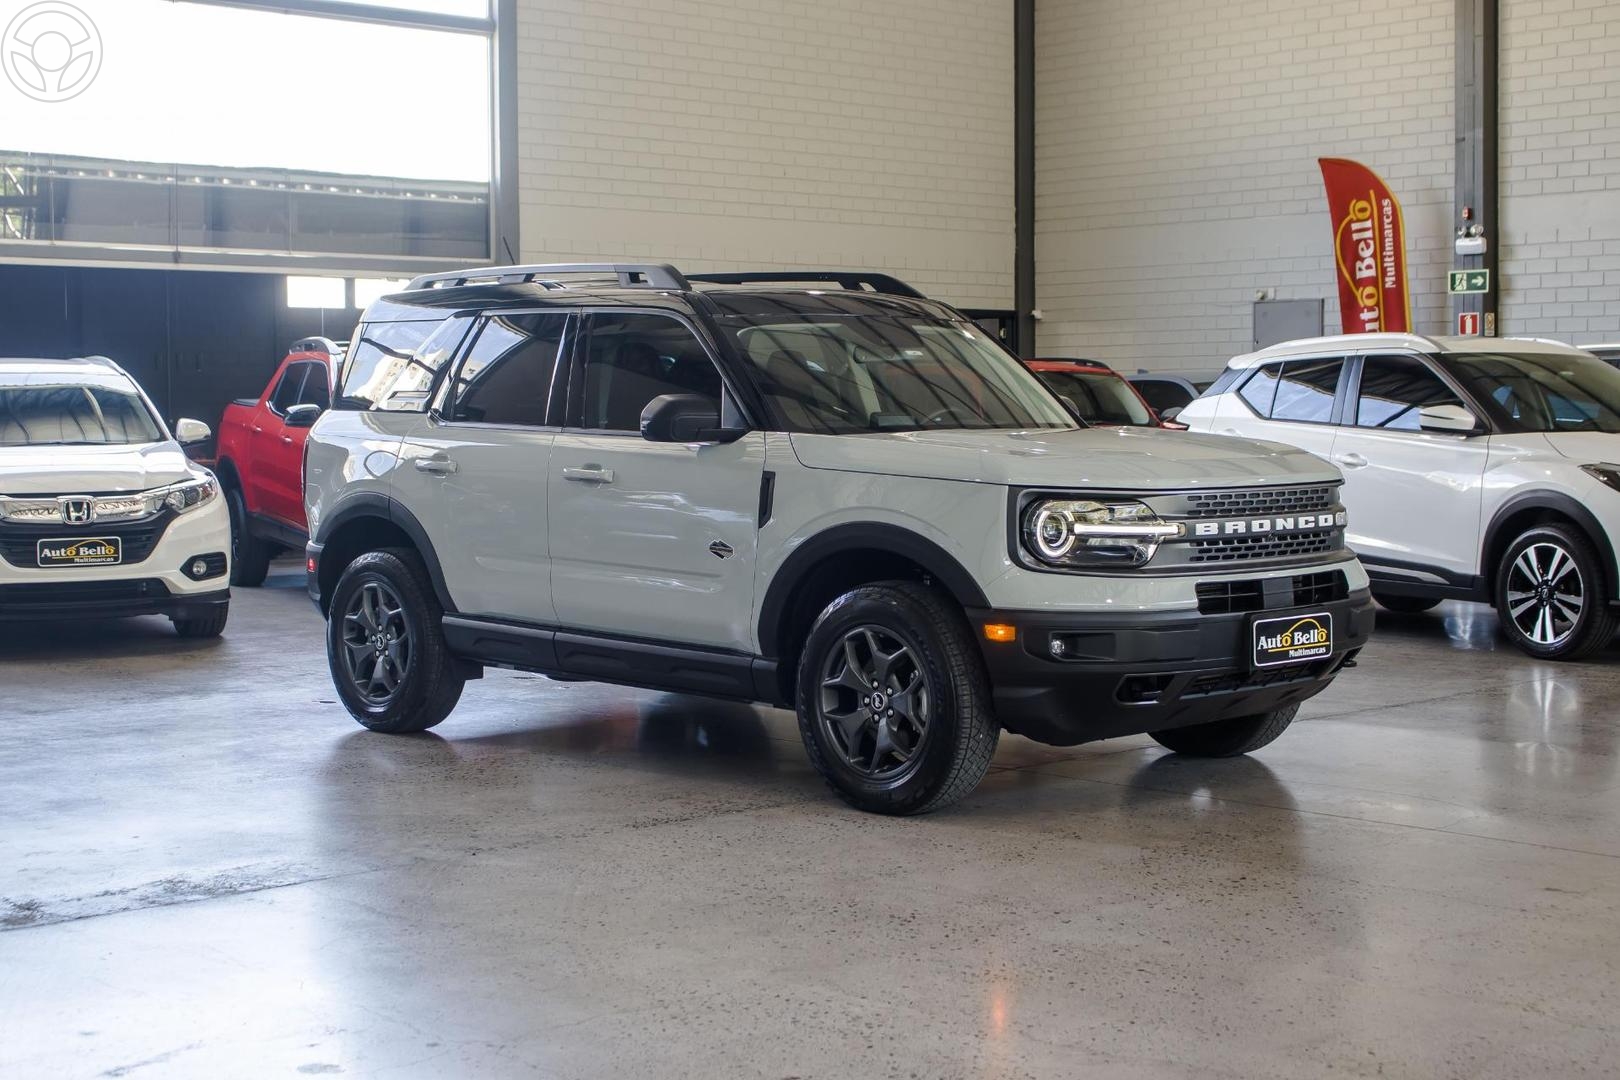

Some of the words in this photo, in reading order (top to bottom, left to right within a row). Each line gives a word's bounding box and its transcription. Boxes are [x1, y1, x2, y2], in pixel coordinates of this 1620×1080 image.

[1350, 199, 1377, 280] Bello
[1382, 198, 1397, 289] Multimarcas
[1195, 513, 1334, 536] BRONCO
[41, 547, 76, 557] Auto
[79, 546, 115, 556] Bello
[1257, 632, 1292, 650] Auto
[1293, 629, 1327, 645] Bello
[1289, 647, 1326, 658] Multimarcas
